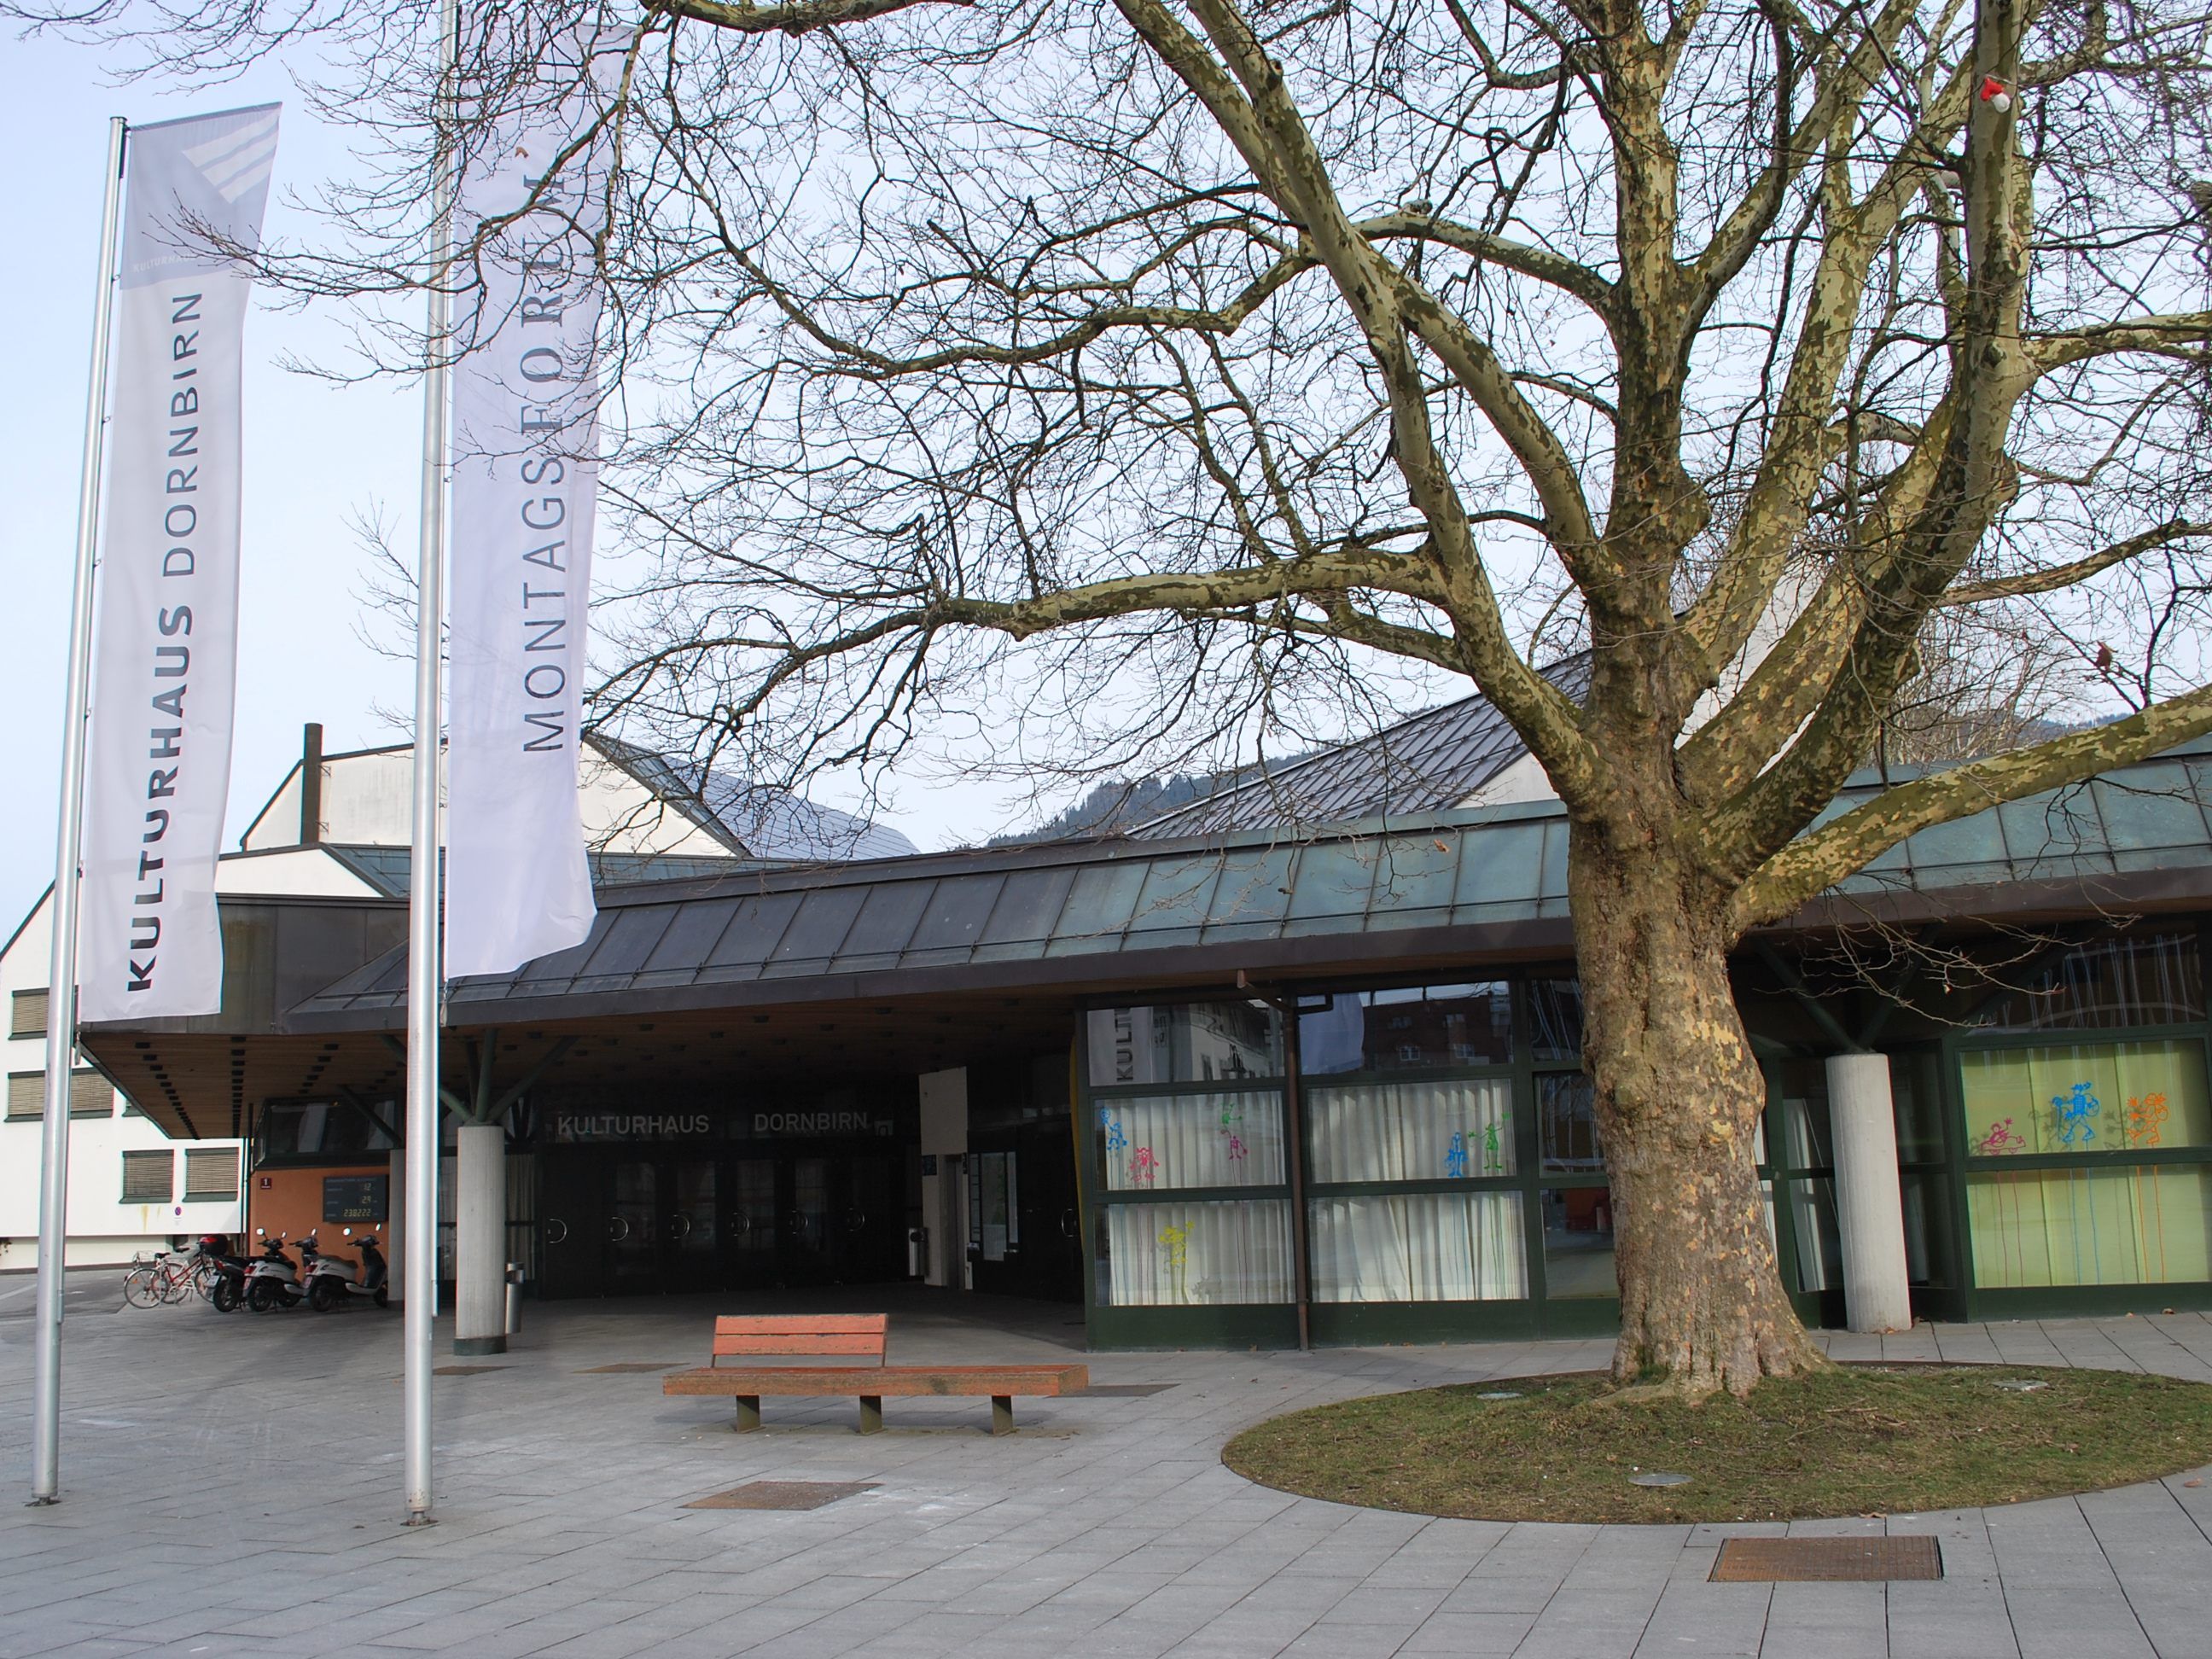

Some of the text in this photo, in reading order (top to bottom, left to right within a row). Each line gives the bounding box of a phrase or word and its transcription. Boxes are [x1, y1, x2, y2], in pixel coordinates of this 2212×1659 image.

[127, 293, 202, 993] KULTURHAUS DORNBIRN
[557, 1112, 867, 1136] KULTURHAUS DORNBIRN
